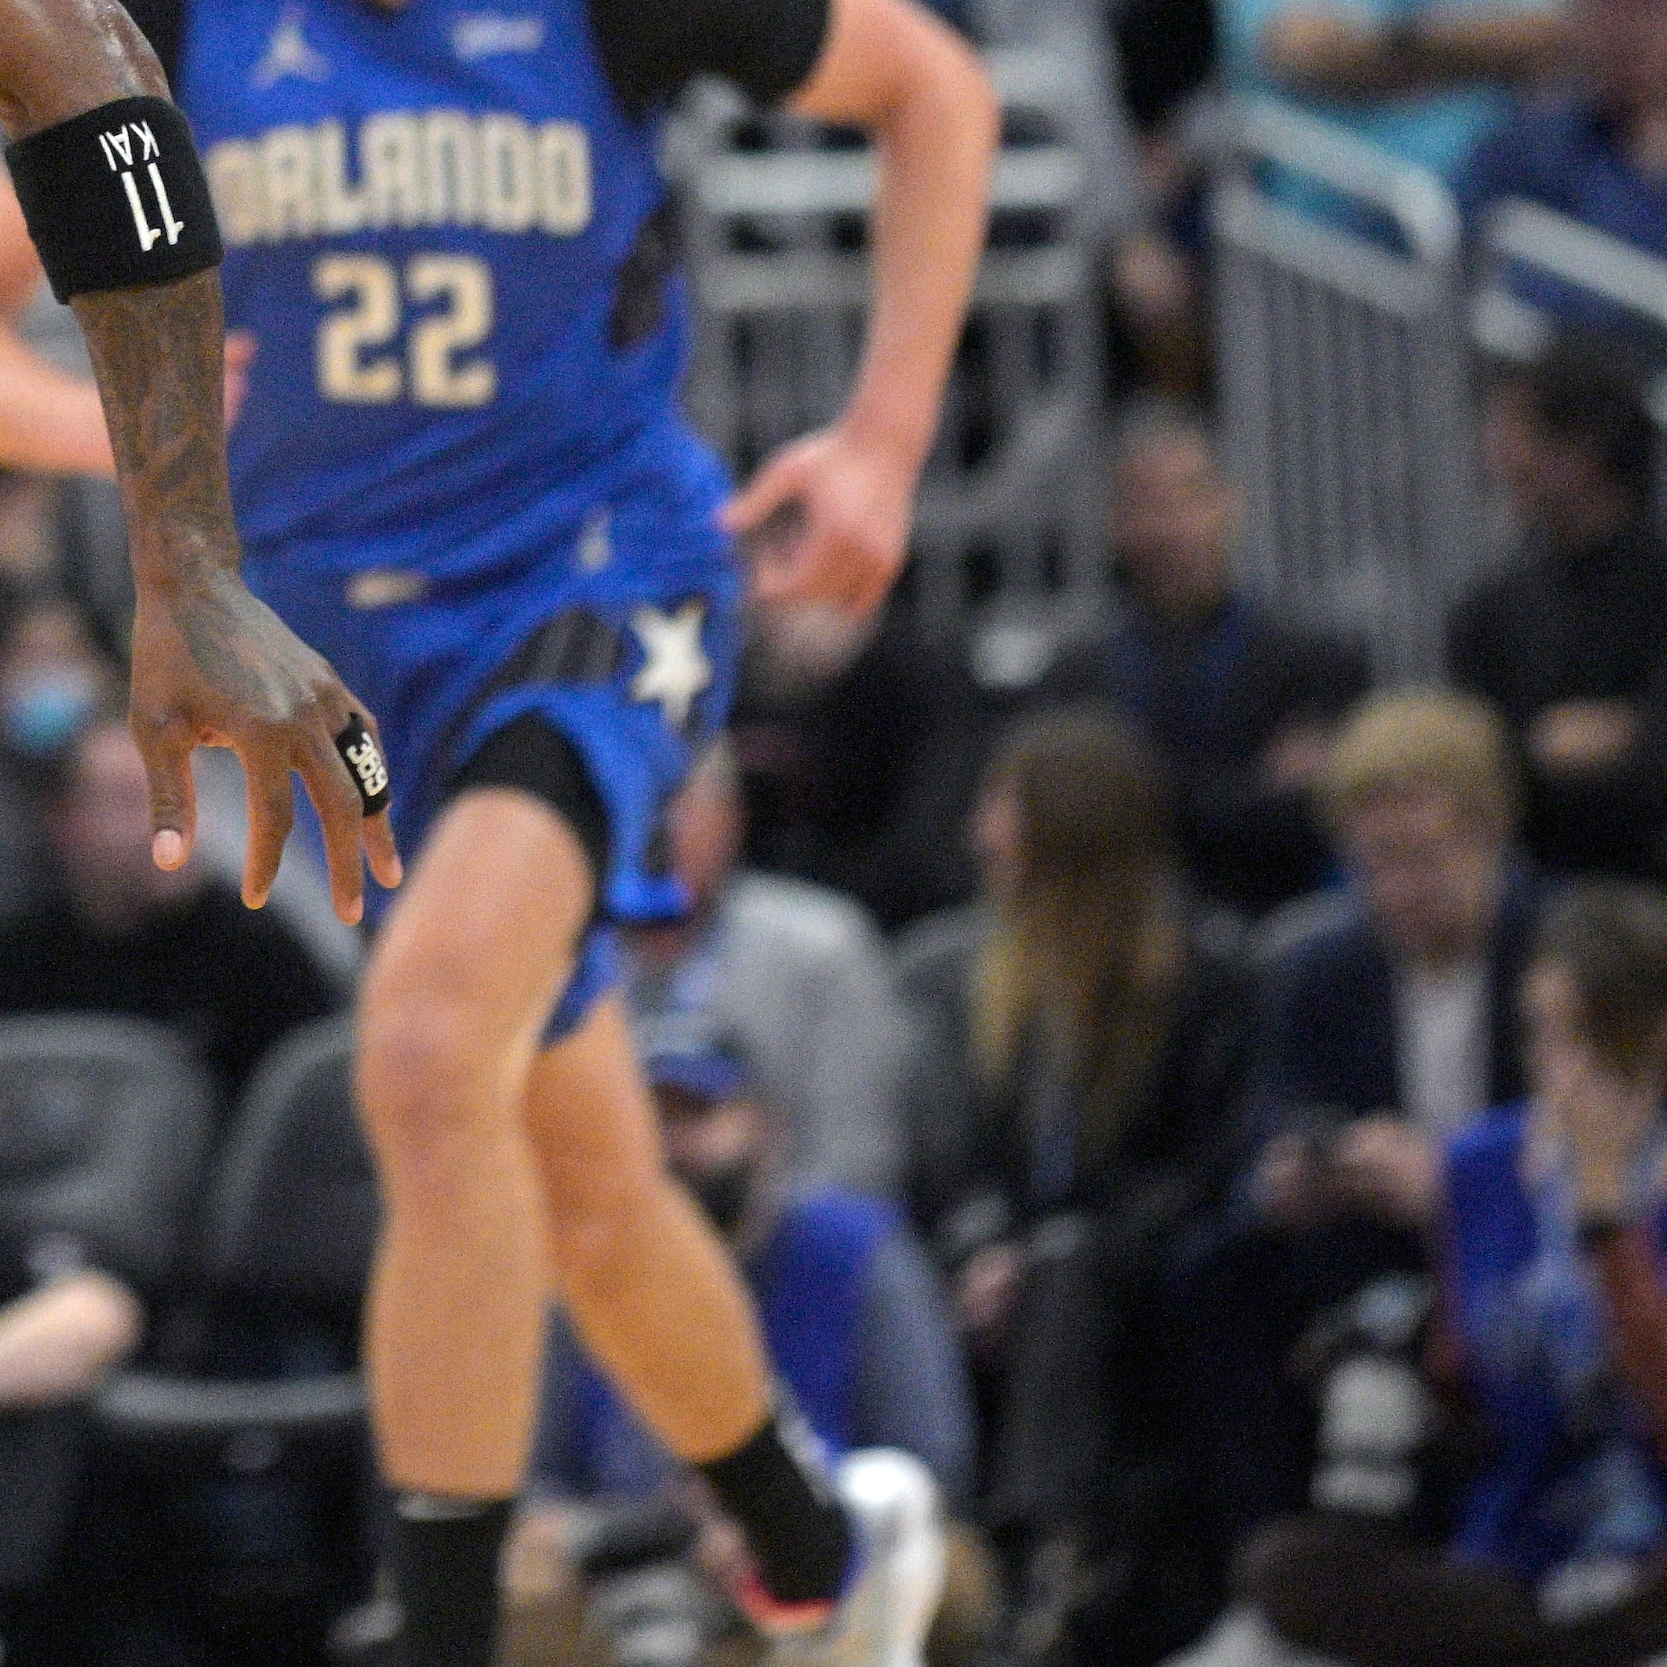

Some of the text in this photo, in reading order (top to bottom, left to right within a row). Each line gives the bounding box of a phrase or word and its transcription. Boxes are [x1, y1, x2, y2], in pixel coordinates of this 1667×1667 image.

[99, 120, 160, 172] KAI
[121, 162, 184, 251] 11
[311, 253, 497, 406] 22
